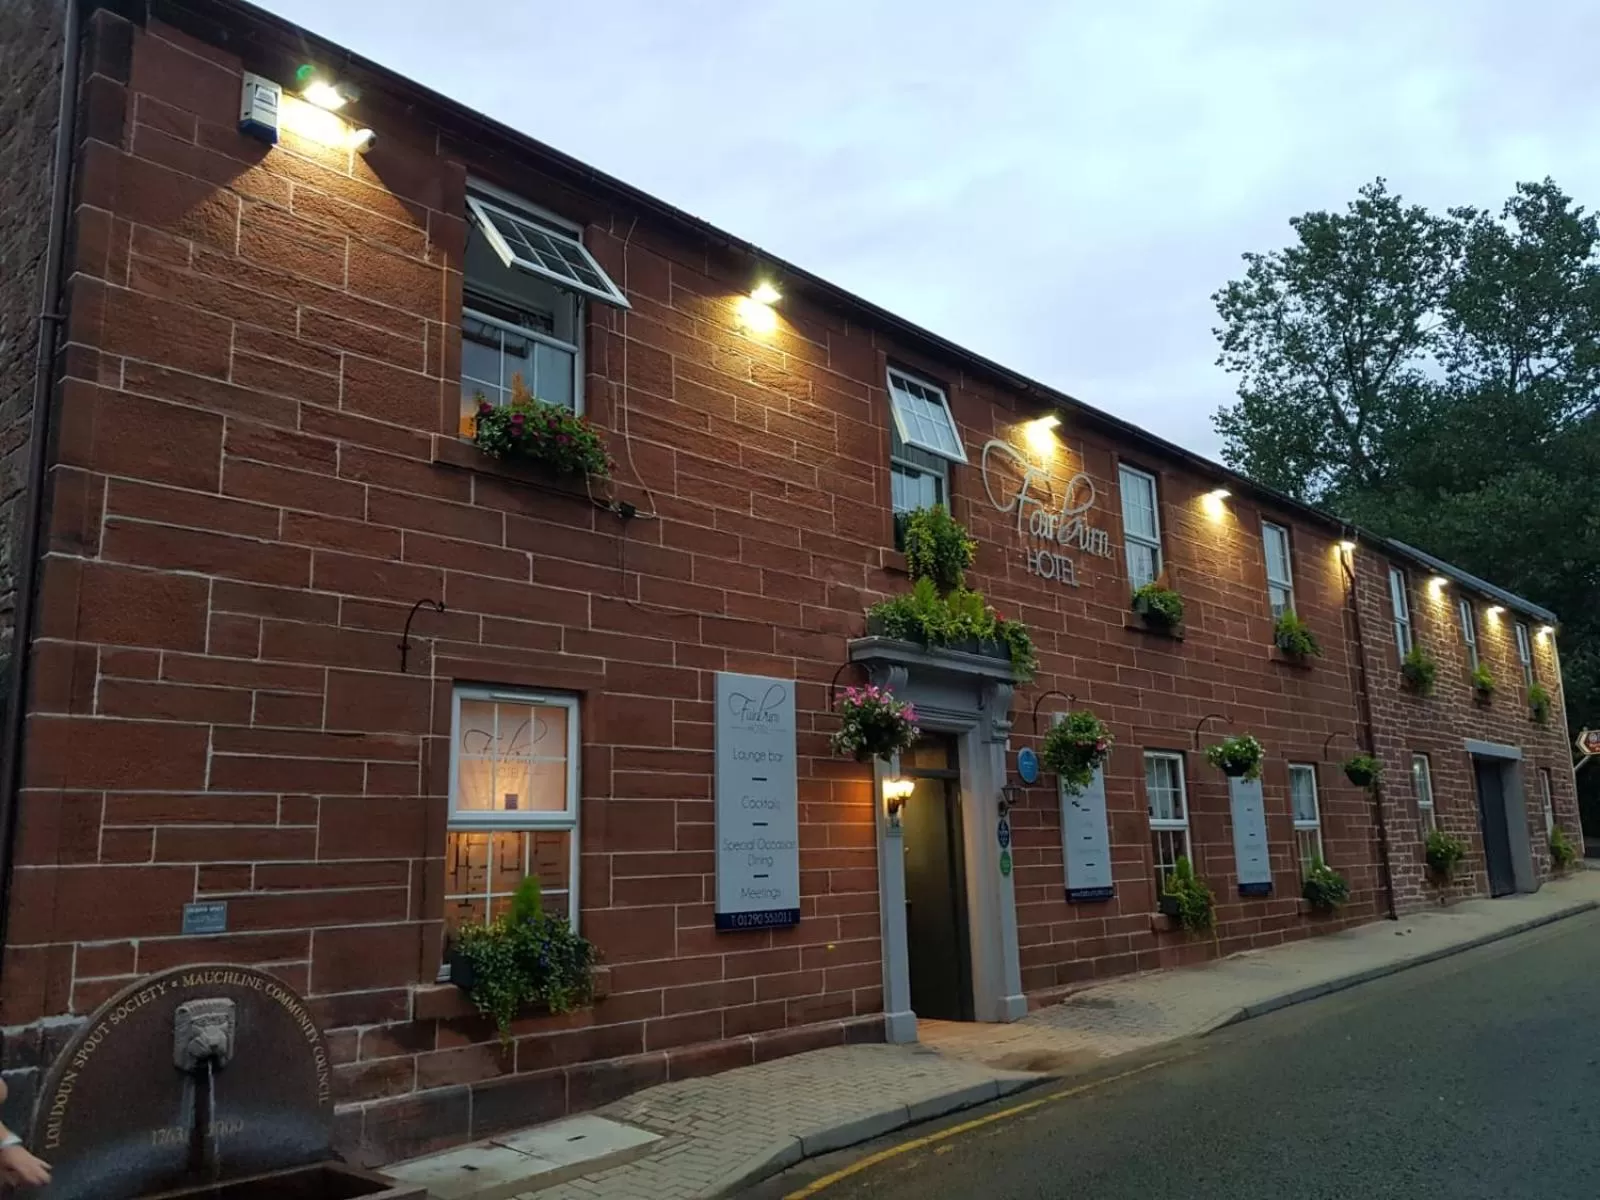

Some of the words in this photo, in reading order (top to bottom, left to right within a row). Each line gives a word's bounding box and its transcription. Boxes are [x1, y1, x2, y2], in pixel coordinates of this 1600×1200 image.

[1026, 546, 1080, 588] HOTEL
[733, 747, 766, 763] Lounge
[45, 1070, 78, 1149] LOUDOUN
[73, 1022, 111, 1068] SPOUT
[109, 981, 166, 1025] SOCIETY
[182, 971, 264, 991] MAUCHLINE
[265, 983, 320, 1044] COMMUNITY
[313, 1046, 331, 1106] COUNCIL
